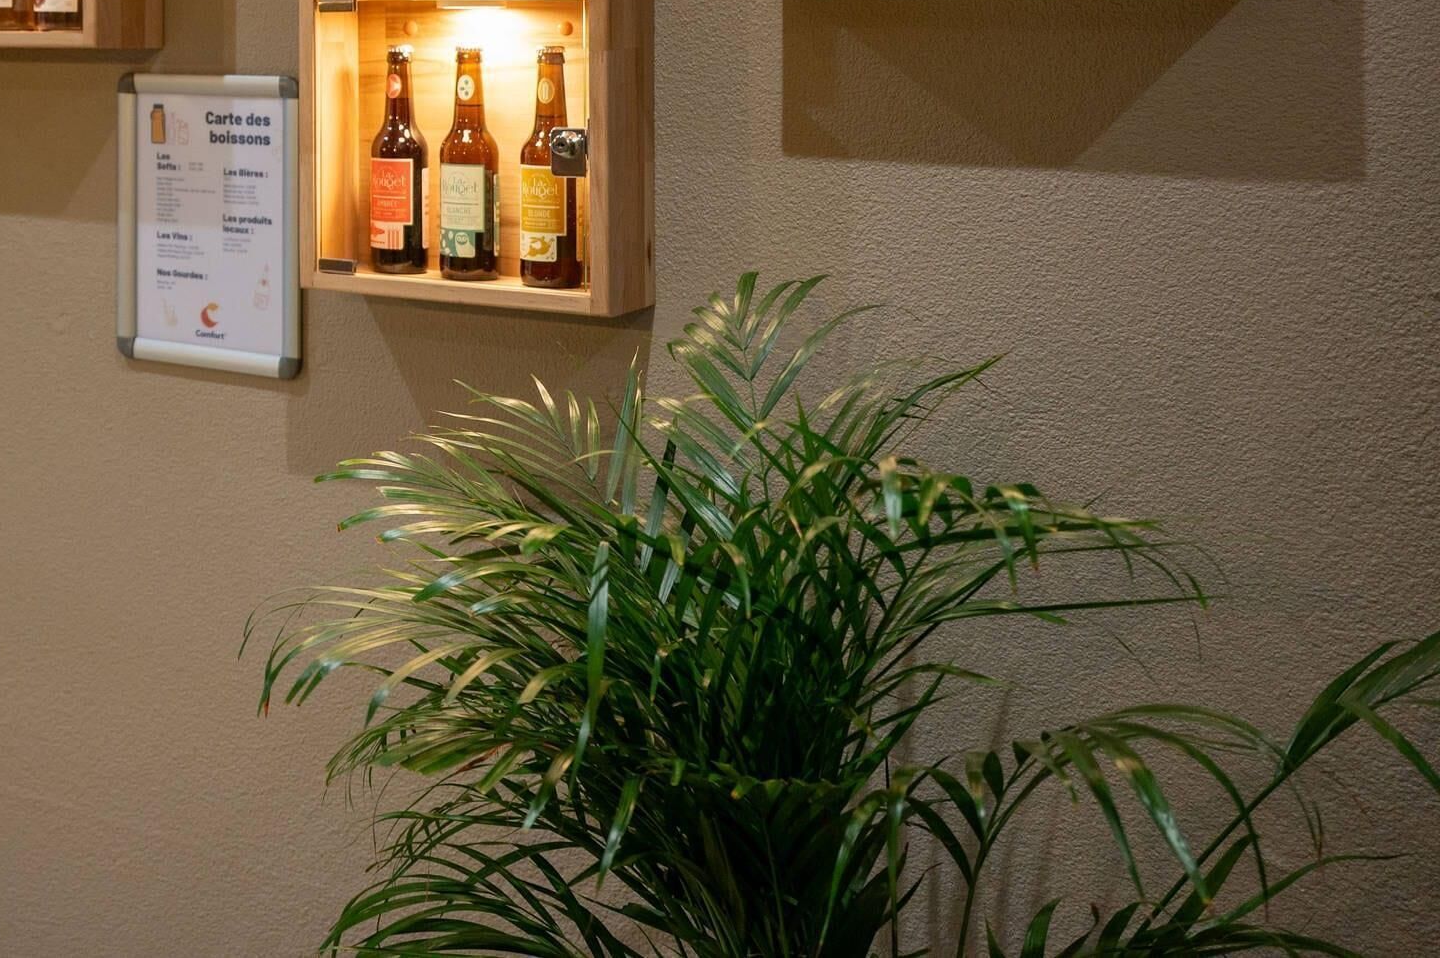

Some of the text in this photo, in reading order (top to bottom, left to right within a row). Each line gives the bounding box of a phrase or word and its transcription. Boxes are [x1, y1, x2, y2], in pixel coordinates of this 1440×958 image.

[205, 111, 271, 126] Carte des
[209, 130, 271, 146] boissons
[156, 152, 170, 161] Les
[223, 168, 263, 178] Les Bières
[222, 214, 273, 226] Les produits
[222, 226, 249, 234] locaux
[157, 231, 188, 241] Les Vins
[157, 268, 204, 280] Nos Gourdes
[195, 329, 224, 340] Comfort
